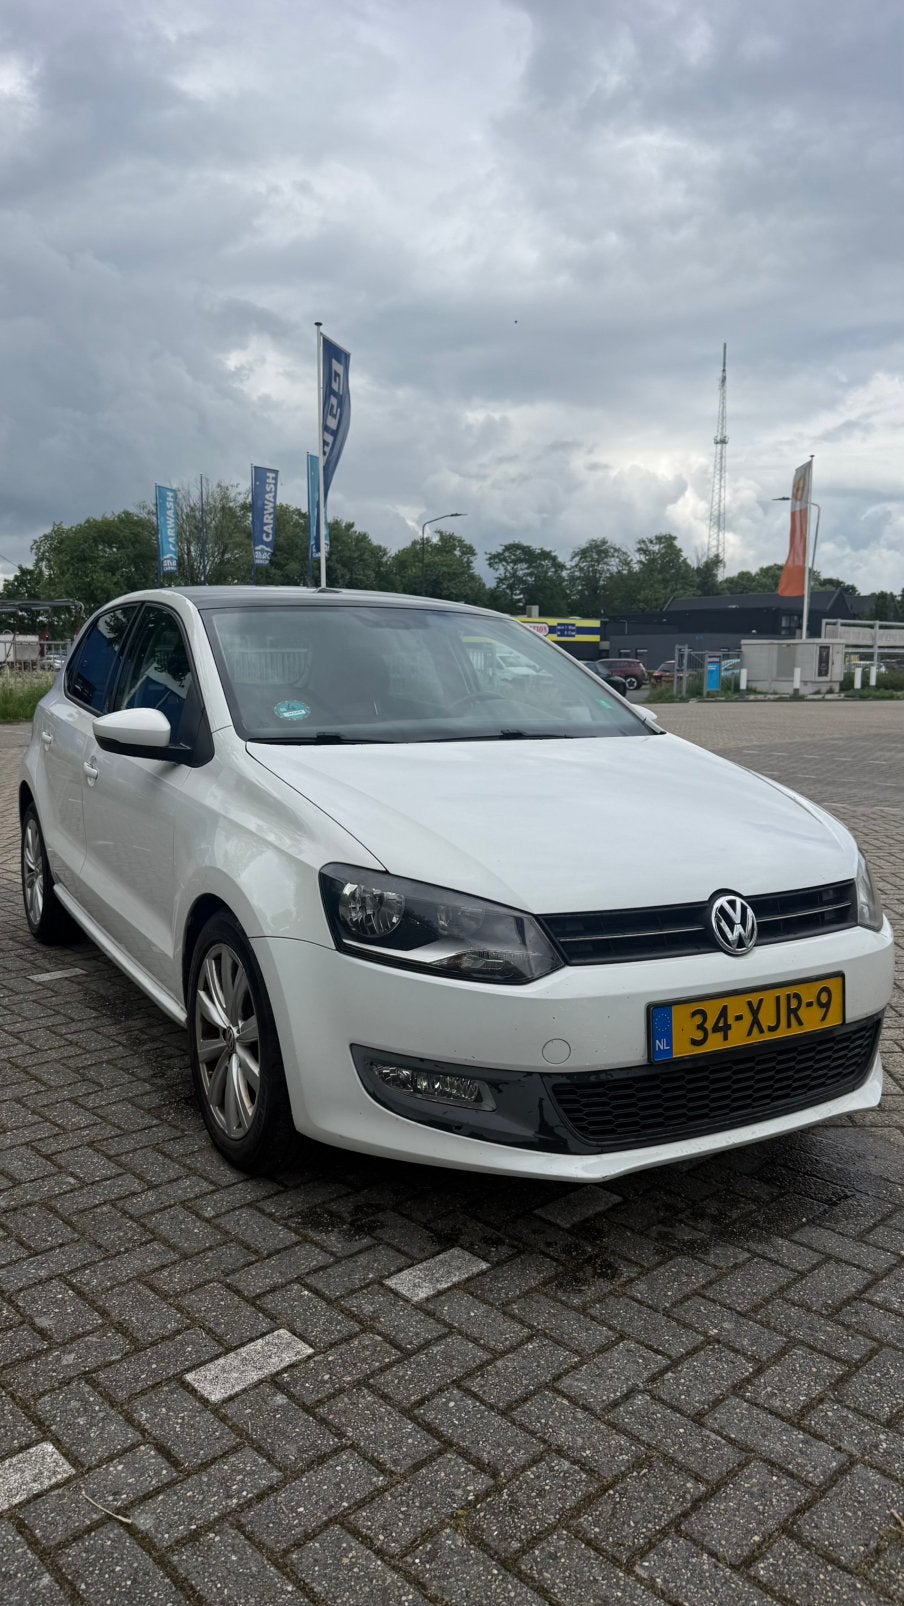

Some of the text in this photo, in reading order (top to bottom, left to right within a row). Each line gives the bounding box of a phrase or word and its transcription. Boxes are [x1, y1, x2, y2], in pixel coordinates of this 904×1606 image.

[262, 472, 276, 542] CARWASH
[655, 1039, 671, 1051] NL
[689, 985, 833, 1047] 34-XJR-9
